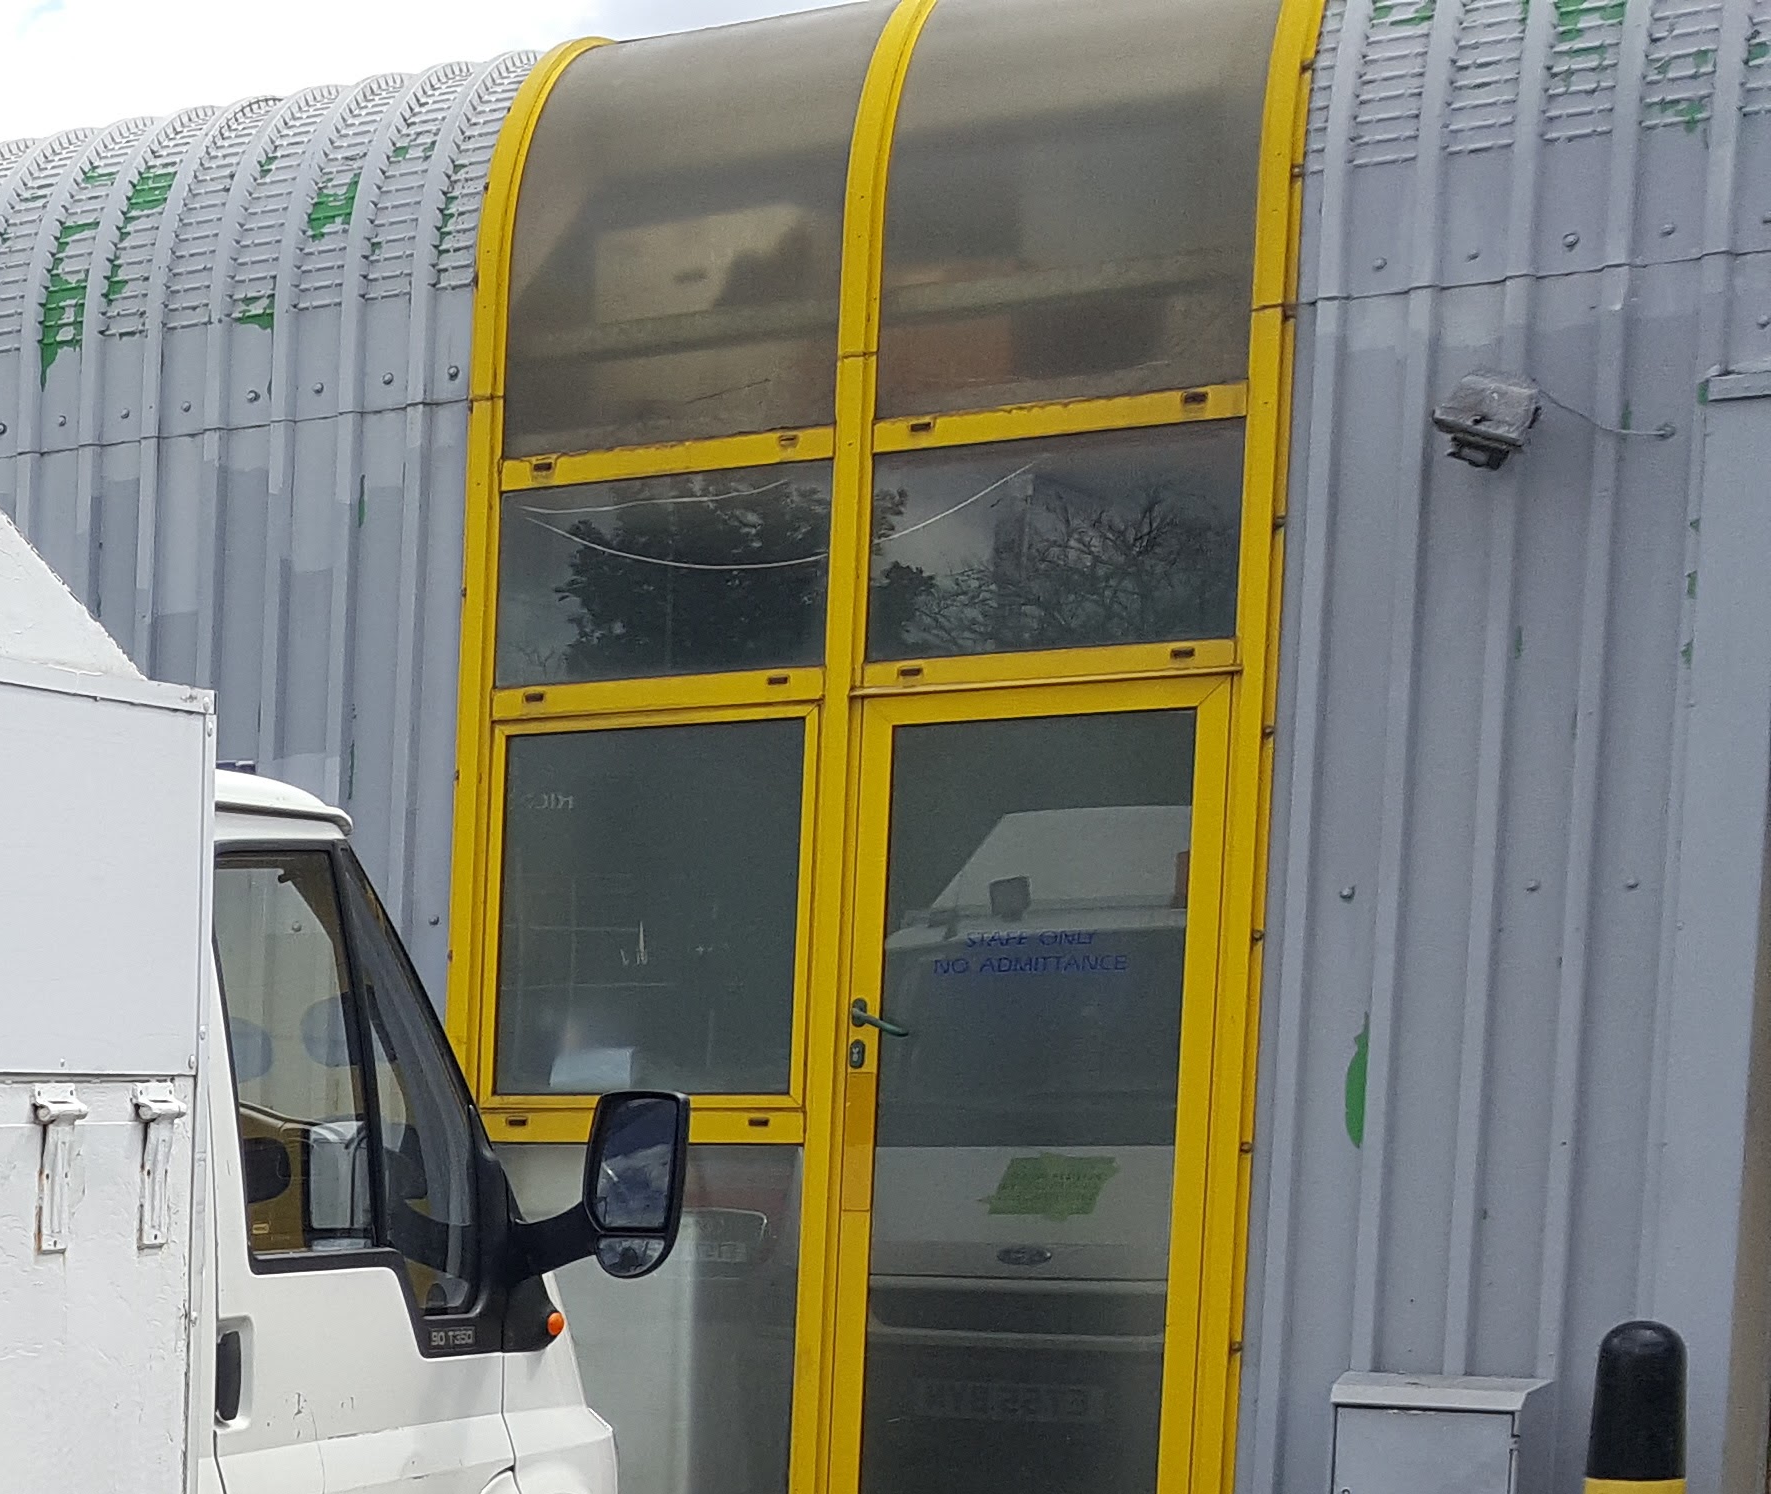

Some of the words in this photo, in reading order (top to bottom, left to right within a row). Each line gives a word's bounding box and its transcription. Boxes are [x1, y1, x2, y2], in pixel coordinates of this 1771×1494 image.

[966, 931, 1027, 948] STAFF
[1039, 930, 1096, 946] ONLY
[934, 958, 969, 974] NO
[979, 955, 1128, 974] ADMITTANCE
